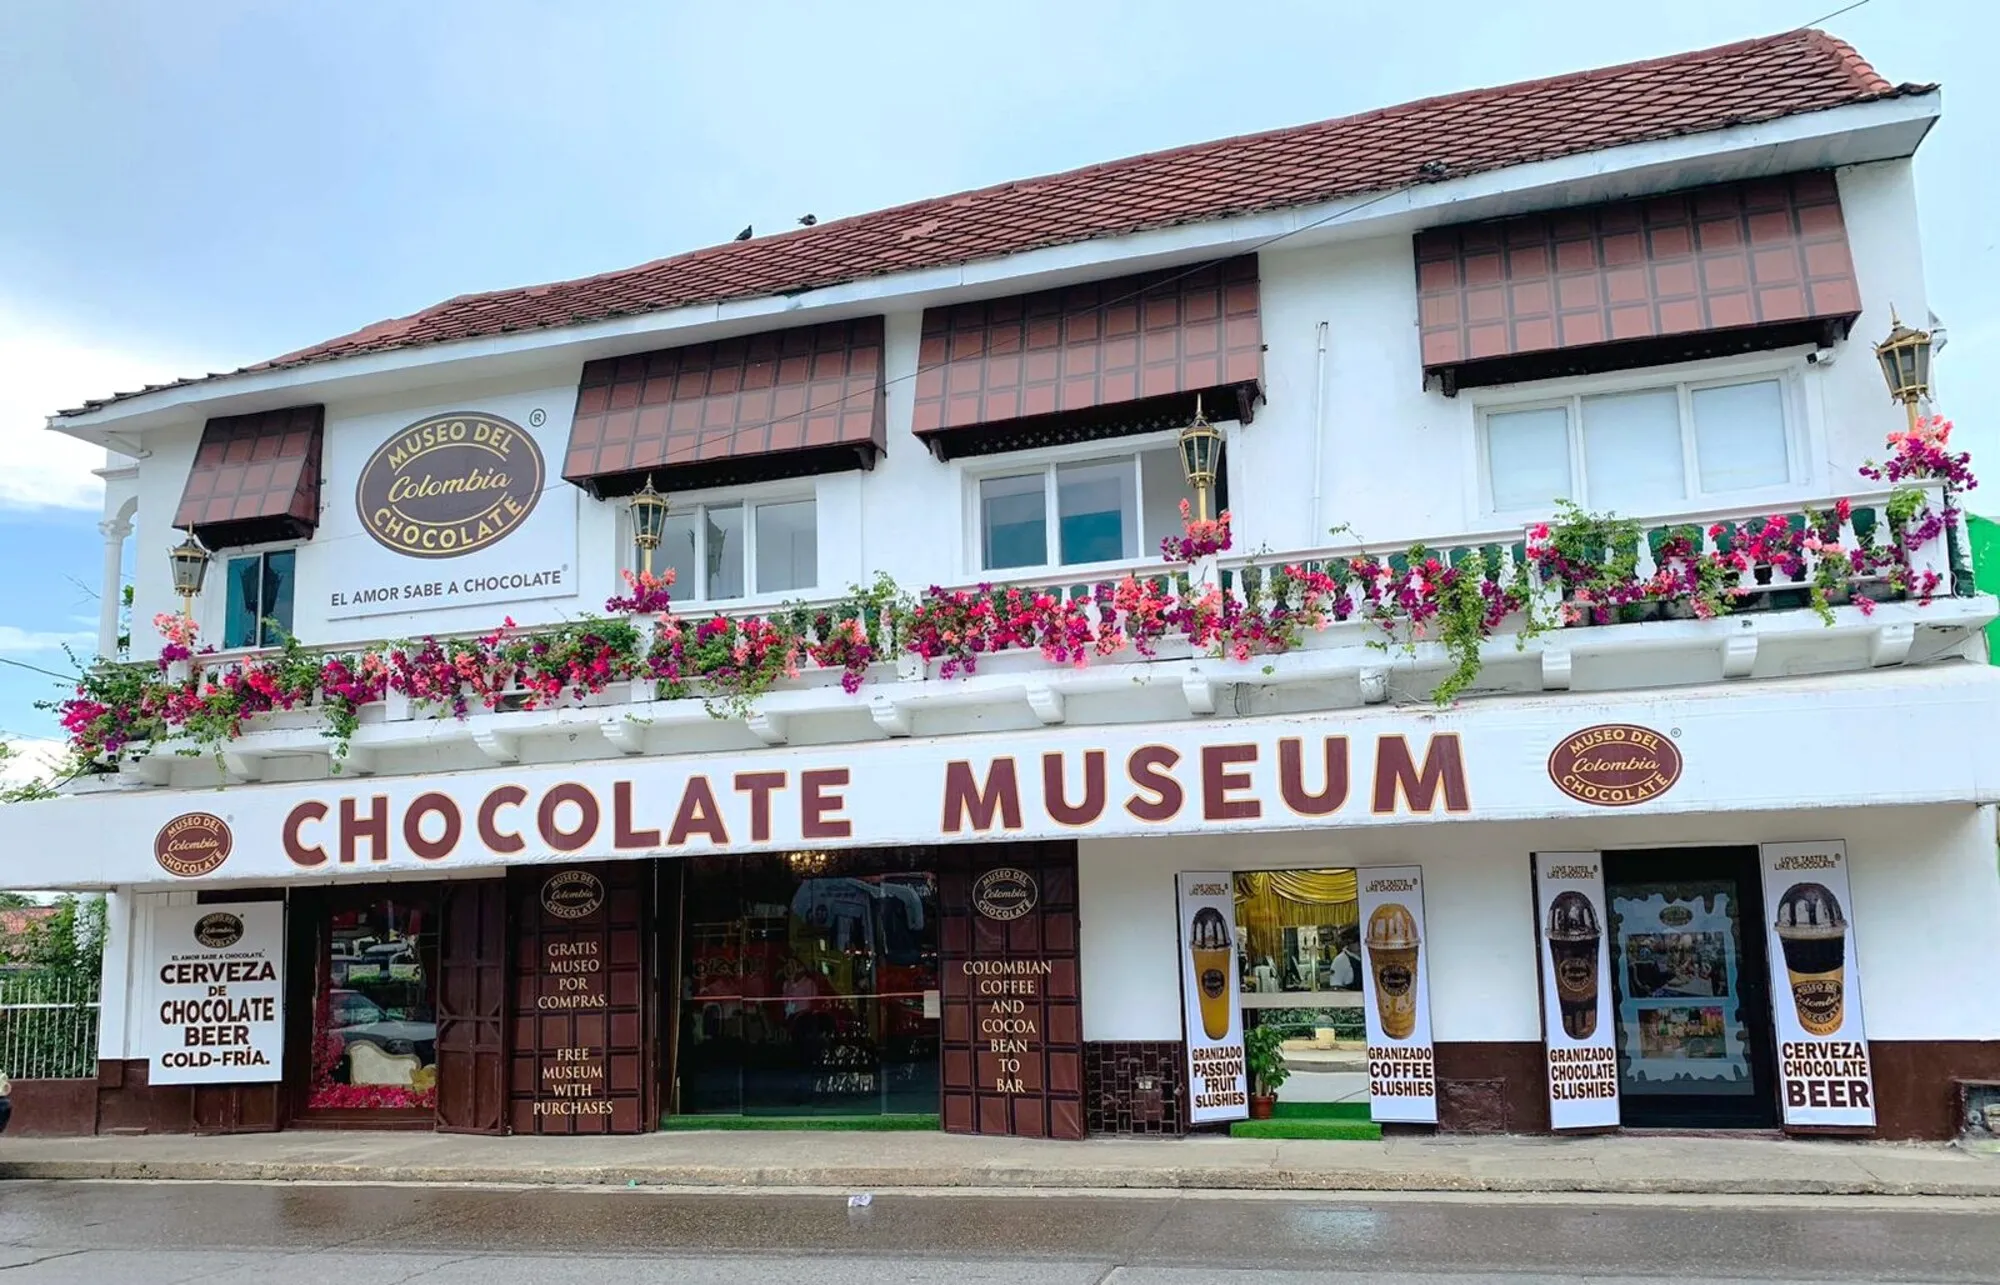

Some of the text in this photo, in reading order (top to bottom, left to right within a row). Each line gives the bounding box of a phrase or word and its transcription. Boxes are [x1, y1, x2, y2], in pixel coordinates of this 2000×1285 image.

[388, 420, 513, 470] MUSEO DEL
[388, 467, 513, 504] Colombia
[374, 495, 522, 549] CHOCOLATE
[331, 570, 561, 606] EL AMOR SABE A CHOCOLATE
[1570, 729, 1659, 754] MUSEO DEL
[1572, 757, 1660, 773] Colombia
[1563, 772, 1668, 800] CHOCOLATE
[283, 732, 1472, 867] CHOCOLATE MUSEUM
[167, 816, 220, 836] MUSEO DEL
[168, 838, 219, 851] Colombia
[162, 850, 224, 873] CHOCOLATE
[551, 873, 595, 887] MUSEO DEL
[983, 870, 1028, 886] MUSEO DEL
[551, 889, 594, 899] Colombia
[983, 888, 1027, 899] Colombia
[547, 899, 598, 916] CHOCOLATE
[979, 900, 1032, 917] CHOCOLATE
[548, 942, 597, 956] GRATIS
[160, 961, 276, 984] CERVEZA
[550, 959, 600, 973] MUSEO
[963, 960, 1053, 976] COLOMBIAN
[209, 985, 226, 997] DE
[559, 977, 588, 991] POR
[980, 980, 1035, 994] COFFEE
[538, 995, 608, 1009] COMPRAS.
[990, 1000, 1025, 1014] AND
[160, 997, 274, 1025] CHOCOLATE
[982, 1018, 1036, 1034] COCOA
[184, 1025, 249, 1047] BEER
[990, 1038, 1028, 1053] BEAN
[1192, 1046, 1242, 1061] GRANIZADO
[1368, 1046, 1432, 1060] GRANIZADO
[1782, 1042, 1865, 1060] CERVEZA
[162, 1047, 270, 1068] COLD-FRÍA.
[557, 1048, 589, 1061] FREE
[1550, 1048, 1613, 1063] GRANIZADO
[542, 1066, 603, 1080] MUSEUM
[999, 1058, 1020, 1073] TO
[1193, 1060, 1242, 1078] PASSION
[1370, 1062, 1433, 1079] COFFEE
[1551, 1064, 1614, 1081] CHOCOLATE
[1783, 1060, 1867, 1078] CHOCOLATE
[553, 1083, 592, 1097] WITH
[996, 1078, 1025, 1093] BAR
[1205, 1077, 1236, 1093] FRUIT
[1371, 1080, 1434, 1097] SLUSHIES
[1552, 1082, 1615, 1100] SLUSHIES
[1195, 1091, 1245, 1108] SLUSHIES
[1787, 1080, 1870, 1108] BEER
[533, 1101, 614, 1116] PURCHASES
